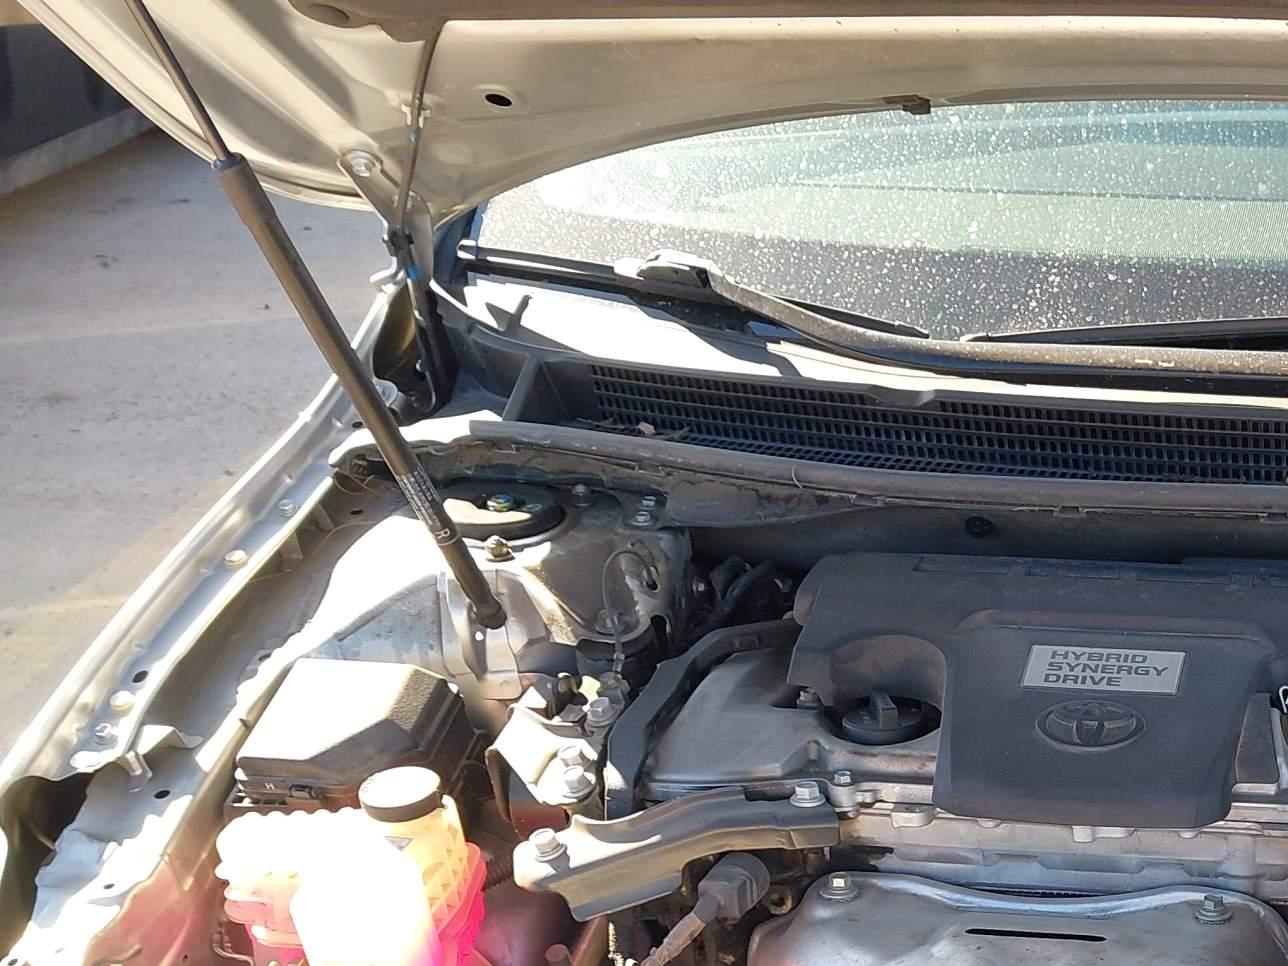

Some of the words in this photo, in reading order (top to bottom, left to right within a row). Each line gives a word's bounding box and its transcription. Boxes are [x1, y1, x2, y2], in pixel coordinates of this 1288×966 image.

[1050, 650, 1147, 664] HYBRID
[1046, 661, 1169, 677] SYNERGY
[1043, 673, 1123, 687] DRIVE
